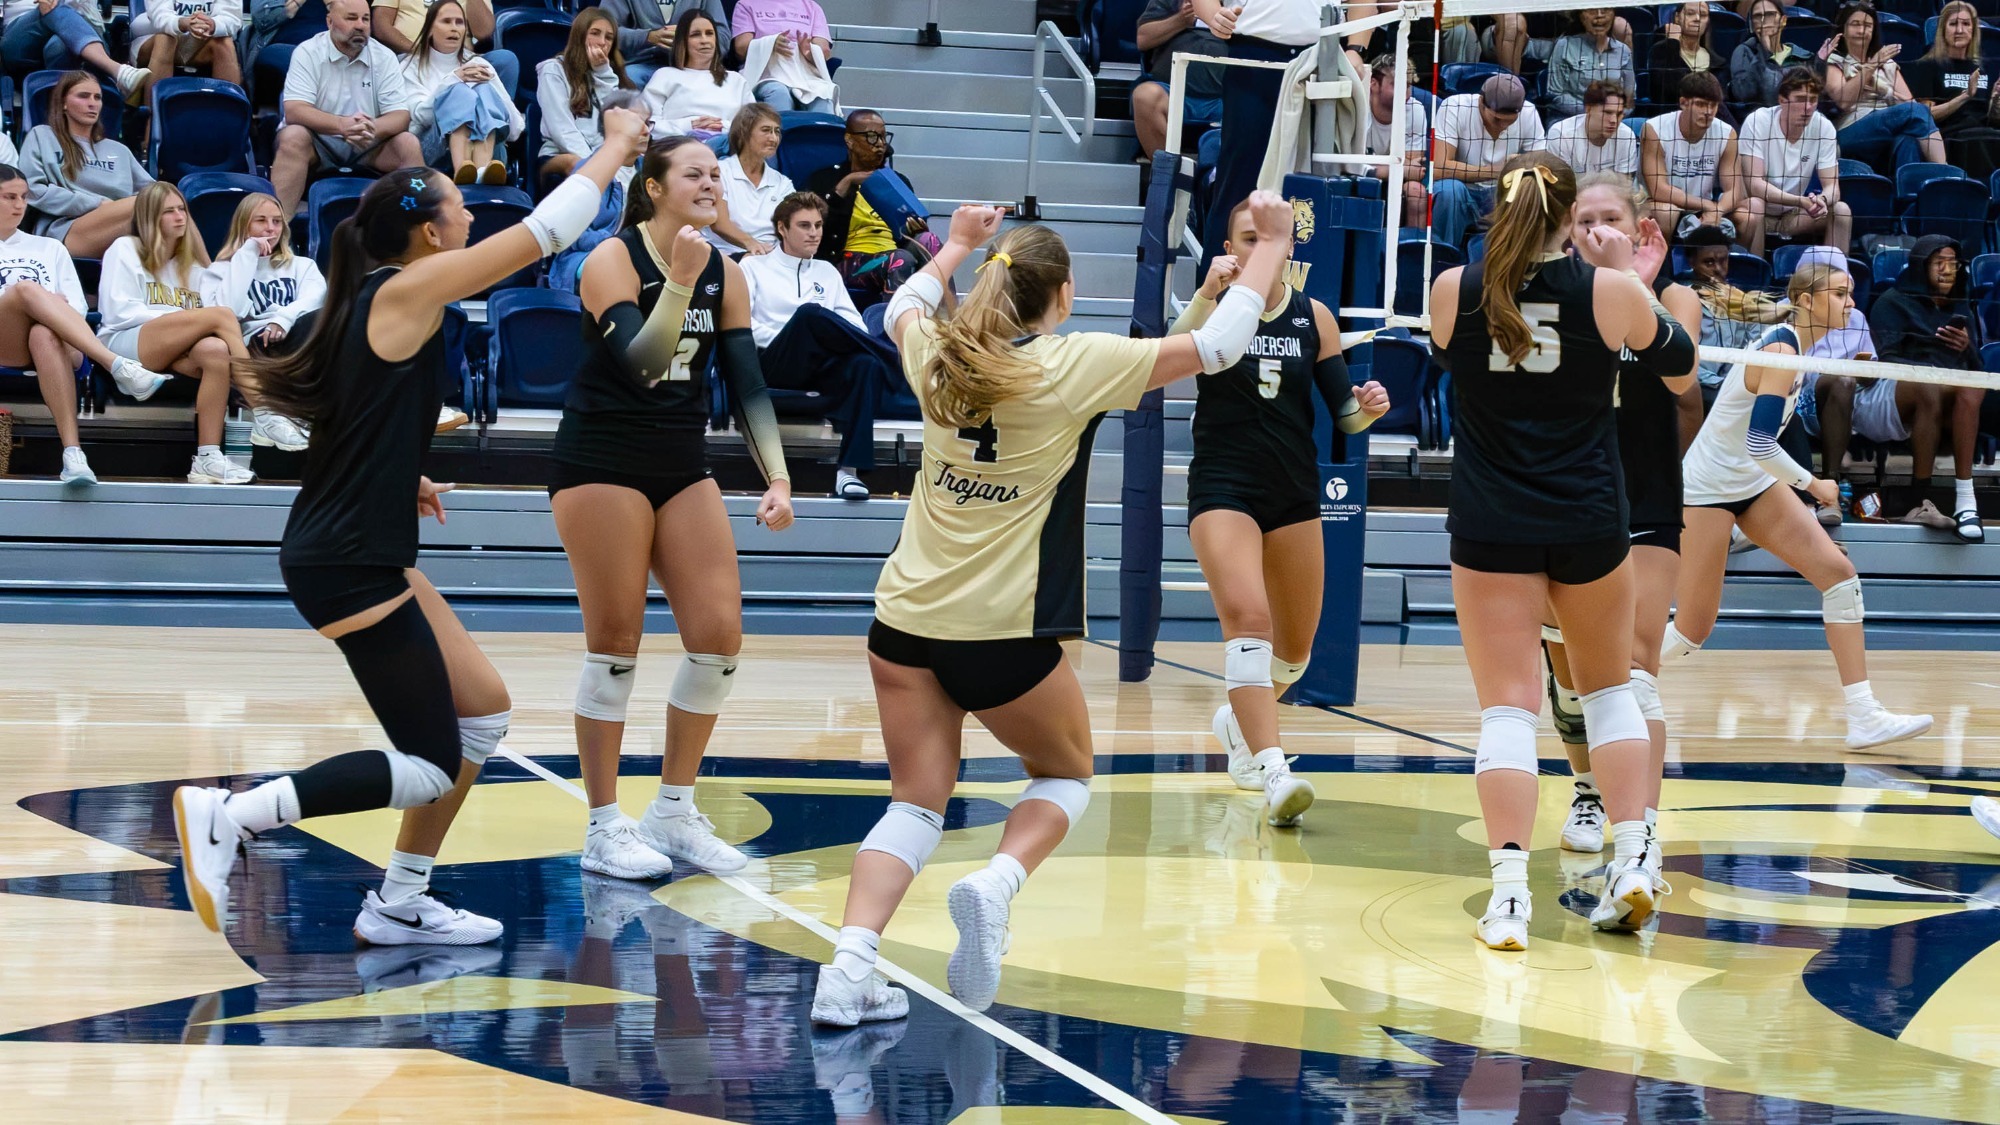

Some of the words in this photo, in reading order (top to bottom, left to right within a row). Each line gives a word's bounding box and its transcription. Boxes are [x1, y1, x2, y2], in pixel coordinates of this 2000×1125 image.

[1244, 335, 1302, 358] NDERSON
[1257, 358, 1282, 399] 5
[956, 411, 1000, 464] 4
[933, 459, 1020, 505] Trojans
